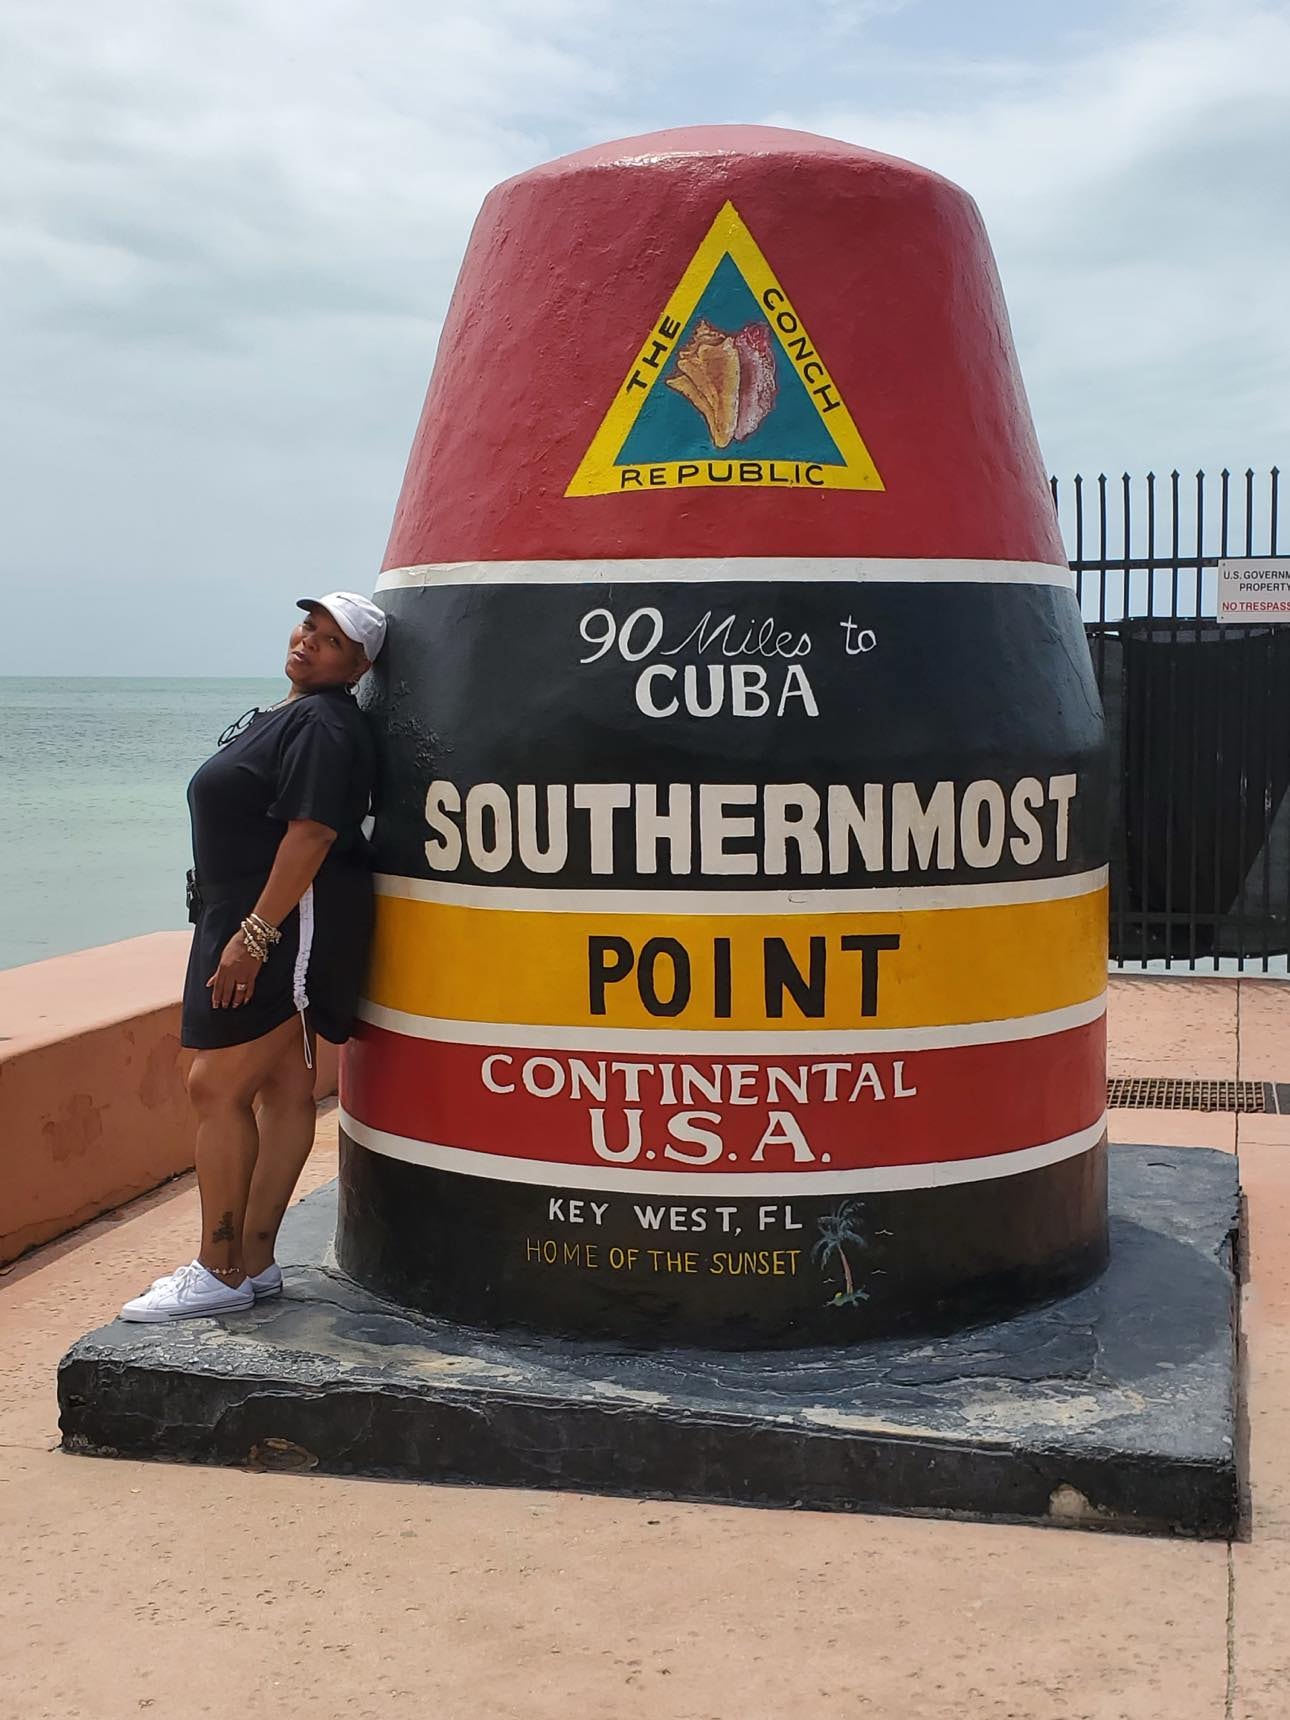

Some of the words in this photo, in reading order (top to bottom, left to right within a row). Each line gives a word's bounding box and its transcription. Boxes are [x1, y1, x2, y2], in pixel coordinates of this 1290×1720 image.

[626, 315, 681, 394] THE
[763, 288, 841, 413] CONCH
[620, 463, 825, 488] REPUBLIC
[1223, 571, 1242, 580] U.S.
[1222, 602, 1238, 611] NO
[579, 607, 664, 664] 90
[660, 610, 812, 658] Miles
[839, 615, 877, 655] to
[635, 664, 820, 718] CUBA
[424, 773, 1077, 875] SOUTHERNMOST
[587, 934, 901, 1018] POINT
[480, 1054, 917, 1105] CONTINENTAL
[588, 1107, 832, 1165] U.S.A.
[548, 1198, 609, 1225] KEY
[633, 1205, 743, 1236] WEST,
[757, 1204, 803, 1230] FL
[526, 1237, 599, 1269] HOME
[608, 1246, 639, 1270] OF
[648, 1249, 699, 1274] THE
[710, 1249, 802, 1275] SUNSET
